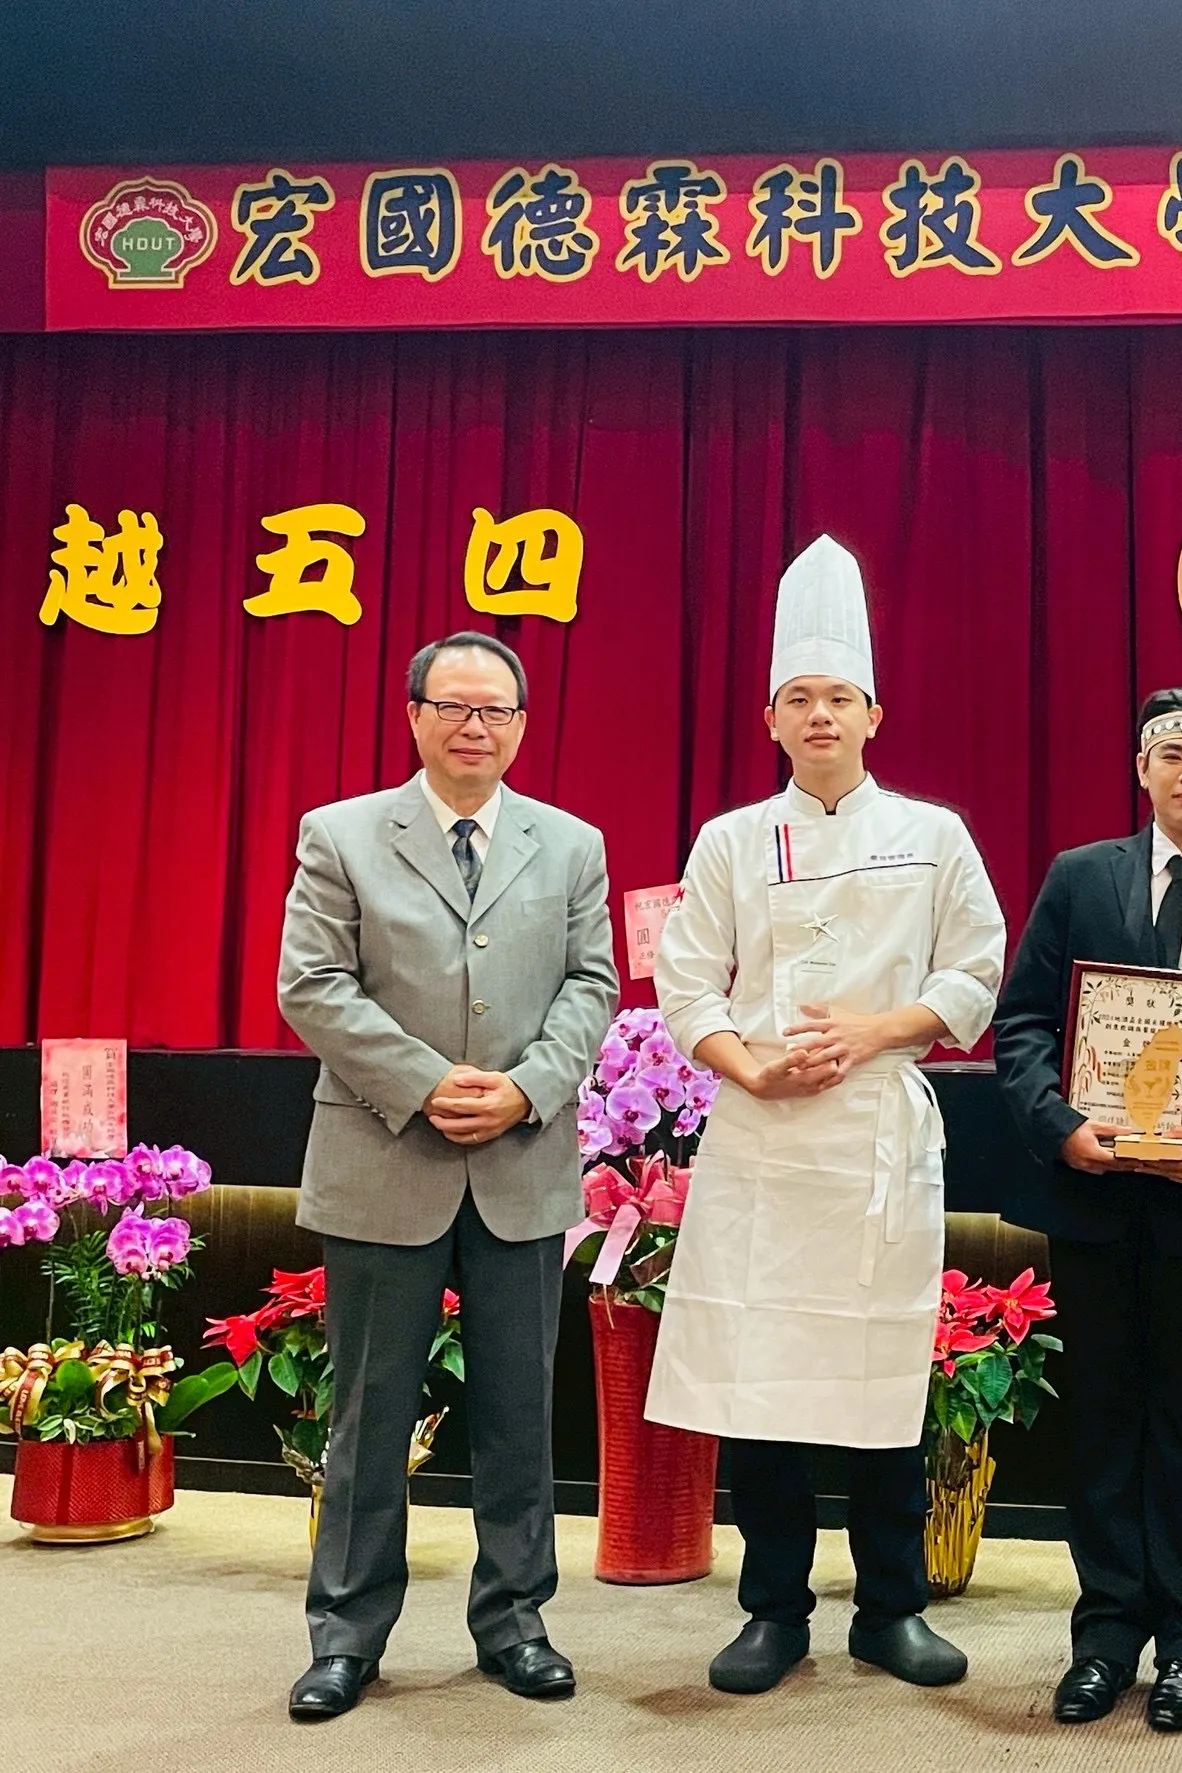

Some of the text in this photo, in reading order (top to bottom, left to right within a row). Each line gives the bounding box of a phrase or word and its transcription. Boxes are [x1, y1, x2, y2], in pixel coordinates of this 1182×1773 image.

[121, 236, 176, 251] HDUT
[39, 503, 584, 635] 越五四
